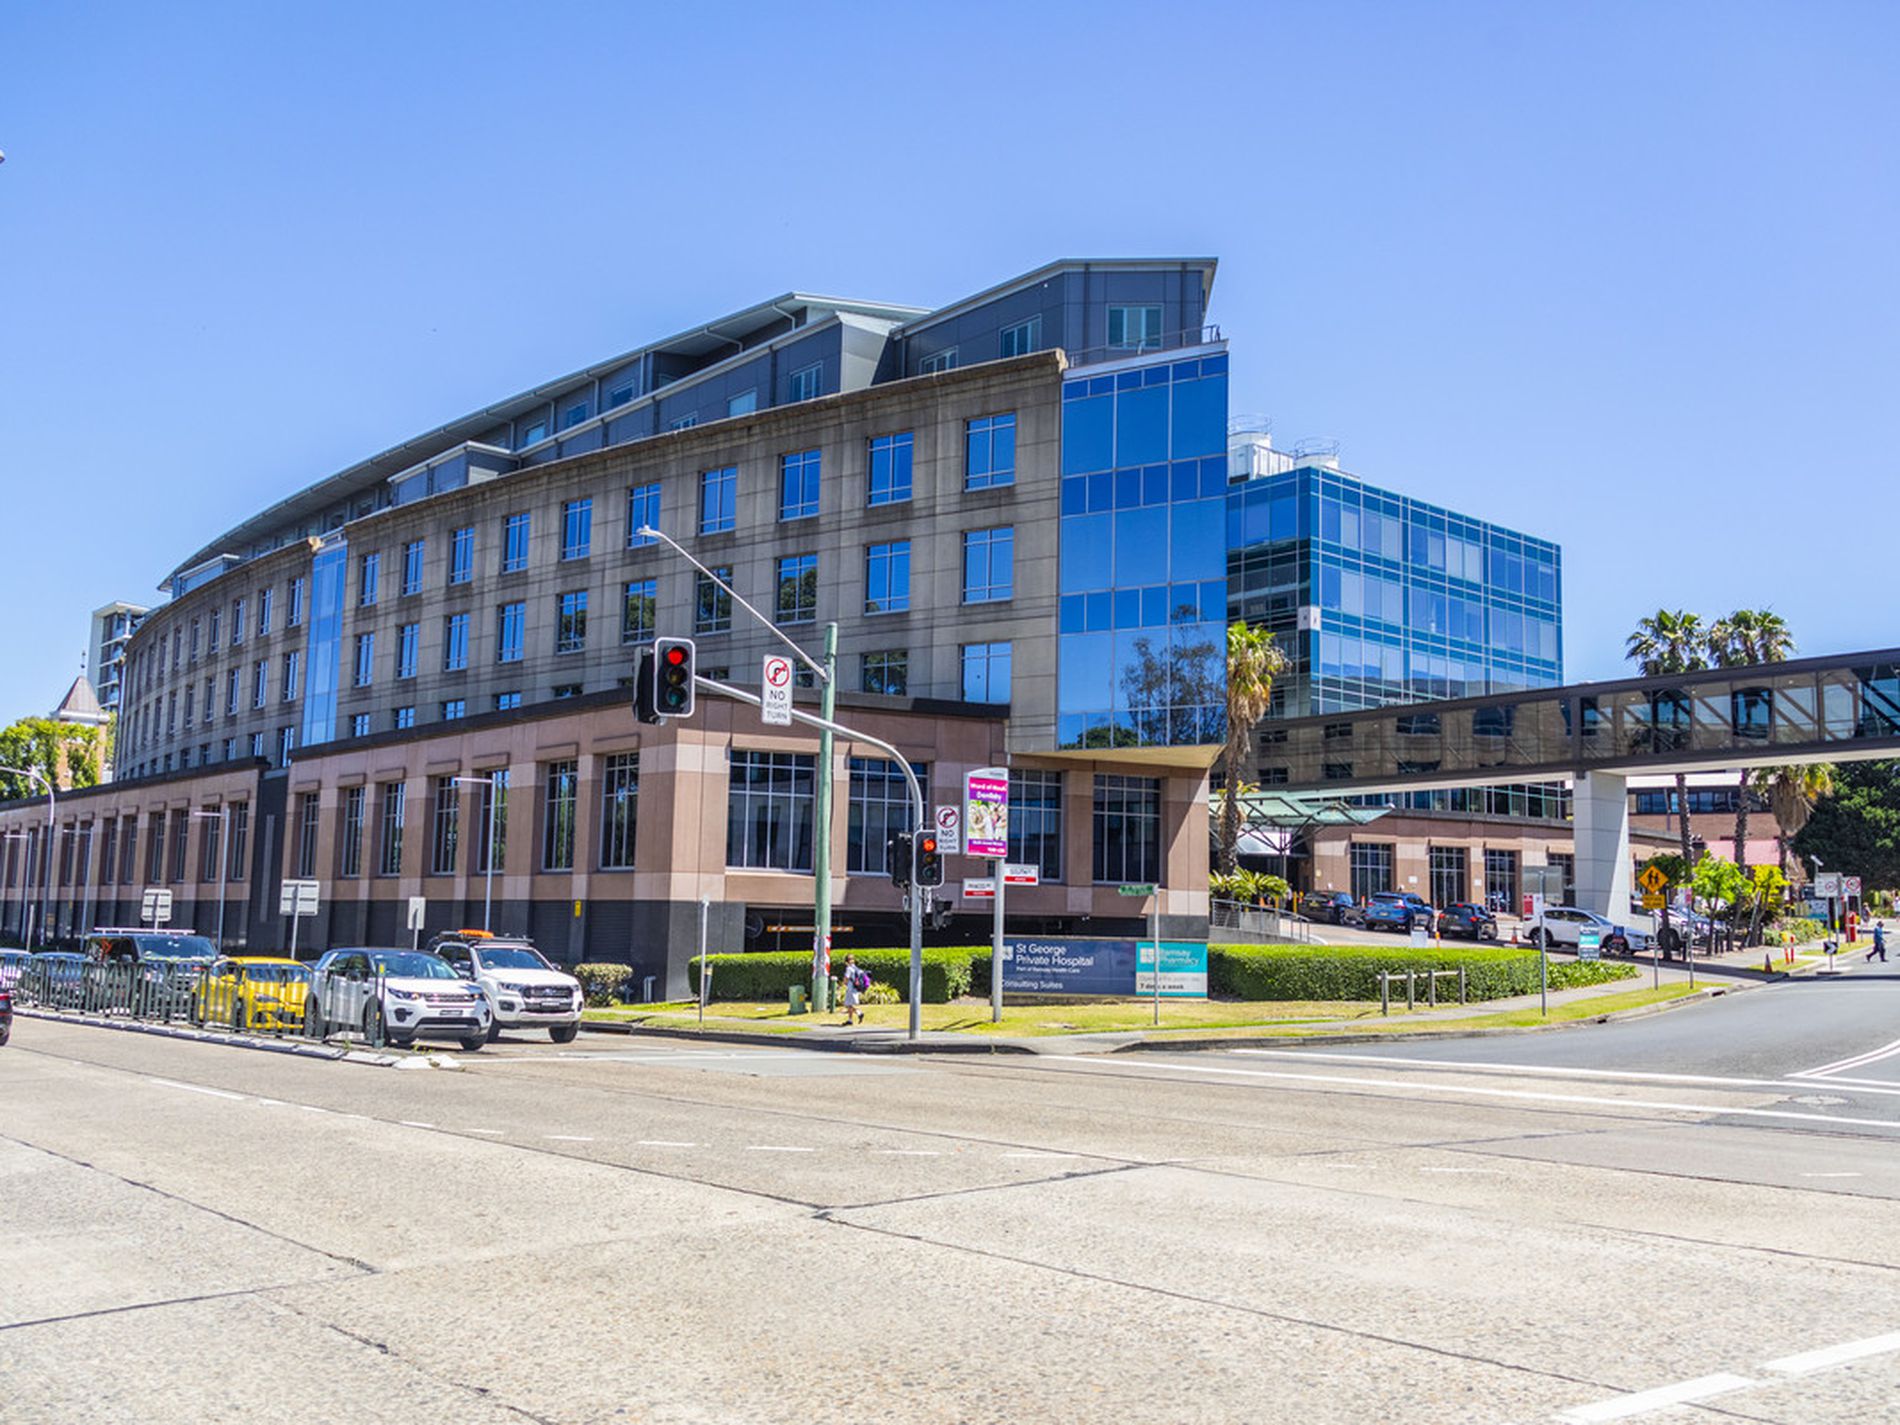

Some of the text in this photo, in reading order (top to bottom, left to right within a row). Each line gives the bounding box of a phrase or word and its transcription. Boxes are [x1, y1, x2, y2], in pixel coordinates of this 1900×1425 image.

[769, 690, 785, 701] NO
[766, 701, 788, 711] RIGHT
[767, 711, 787, 720] TURN
[1016, 943, 1067, 956] St George
[1016, 954, 1094, 967] Private Hospital
[1040, 981, 1063, 990] Suites
